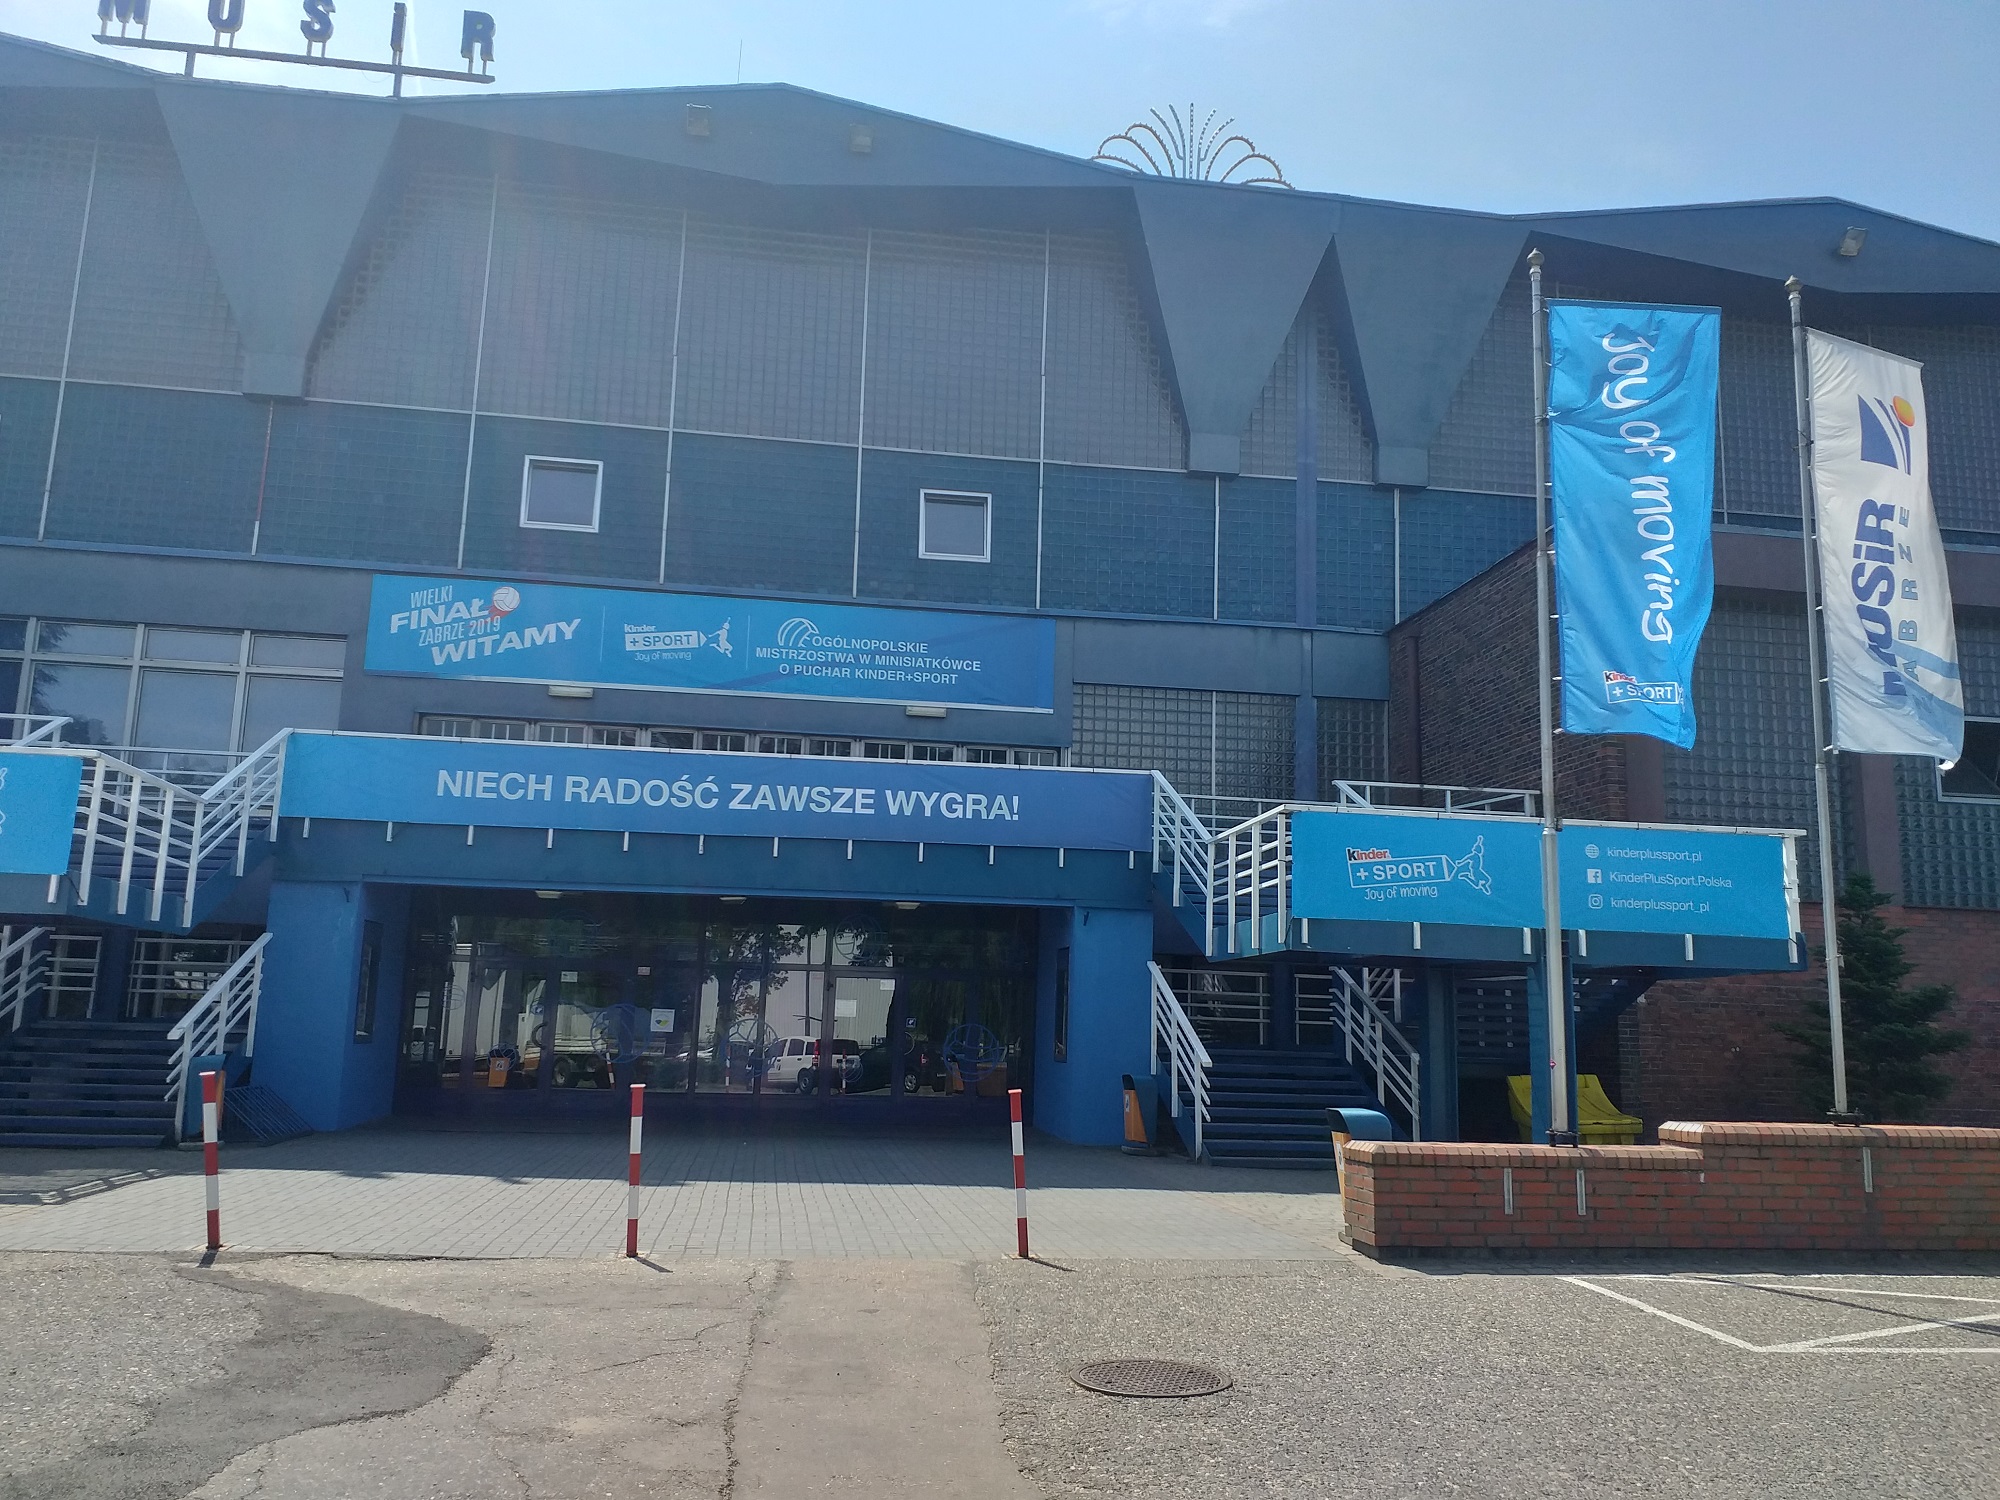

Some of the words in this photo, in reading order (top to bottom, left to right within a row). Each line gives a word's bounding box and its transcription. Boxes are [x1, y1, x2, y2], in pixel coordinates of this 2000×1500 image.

[1602, 332, 1655, 410] Joy
[1619, 420, 1676, 463] of
[1629, 475, 1681, 645] moving
[410, 585, 453, 609] WIELKI
[390, 598, 490, 634] FINAŁ
[419, 621, 465, 647] ZABRZE
[469, 615, 501, 638] 2019
[431, 618, 582, 666] WITAMY
[642, 634, 693, 647] SPORT
[811, 634, 929, 654] OGÓLNOPOLSKIE
[756, 647, 856, 664] MISTRZOSTWA
[859, 653, 872, 665] W
[875, 654, 981, 672] MINISIATKÓWCE
[779, 663, 790, 675] O
[793, 664, 851, 679] PUCHAR
[855, 668, 959, 685] KINDER+SPORT
[437, 769, 554, 801] NIECH
[564, 774, 720, 809] RADOŚĆ
[728, 783, 876, 815] ZAWSZE
[885, 789, 1019, 821] WYGRA!
[1607, 846, 1702, 863] kinderplussport.pl
[1372, 861, 1437, 881] SPORT
[1609, 871, 1733, 889] KinderPlusSport.Polska
[1364, 888, 1384, 902] Joy
[1386, 886, 1398, 898] of
[1400, 884, 1438, 898] moving
[1610, 897, 1710, 914] kinderplussport_pl
